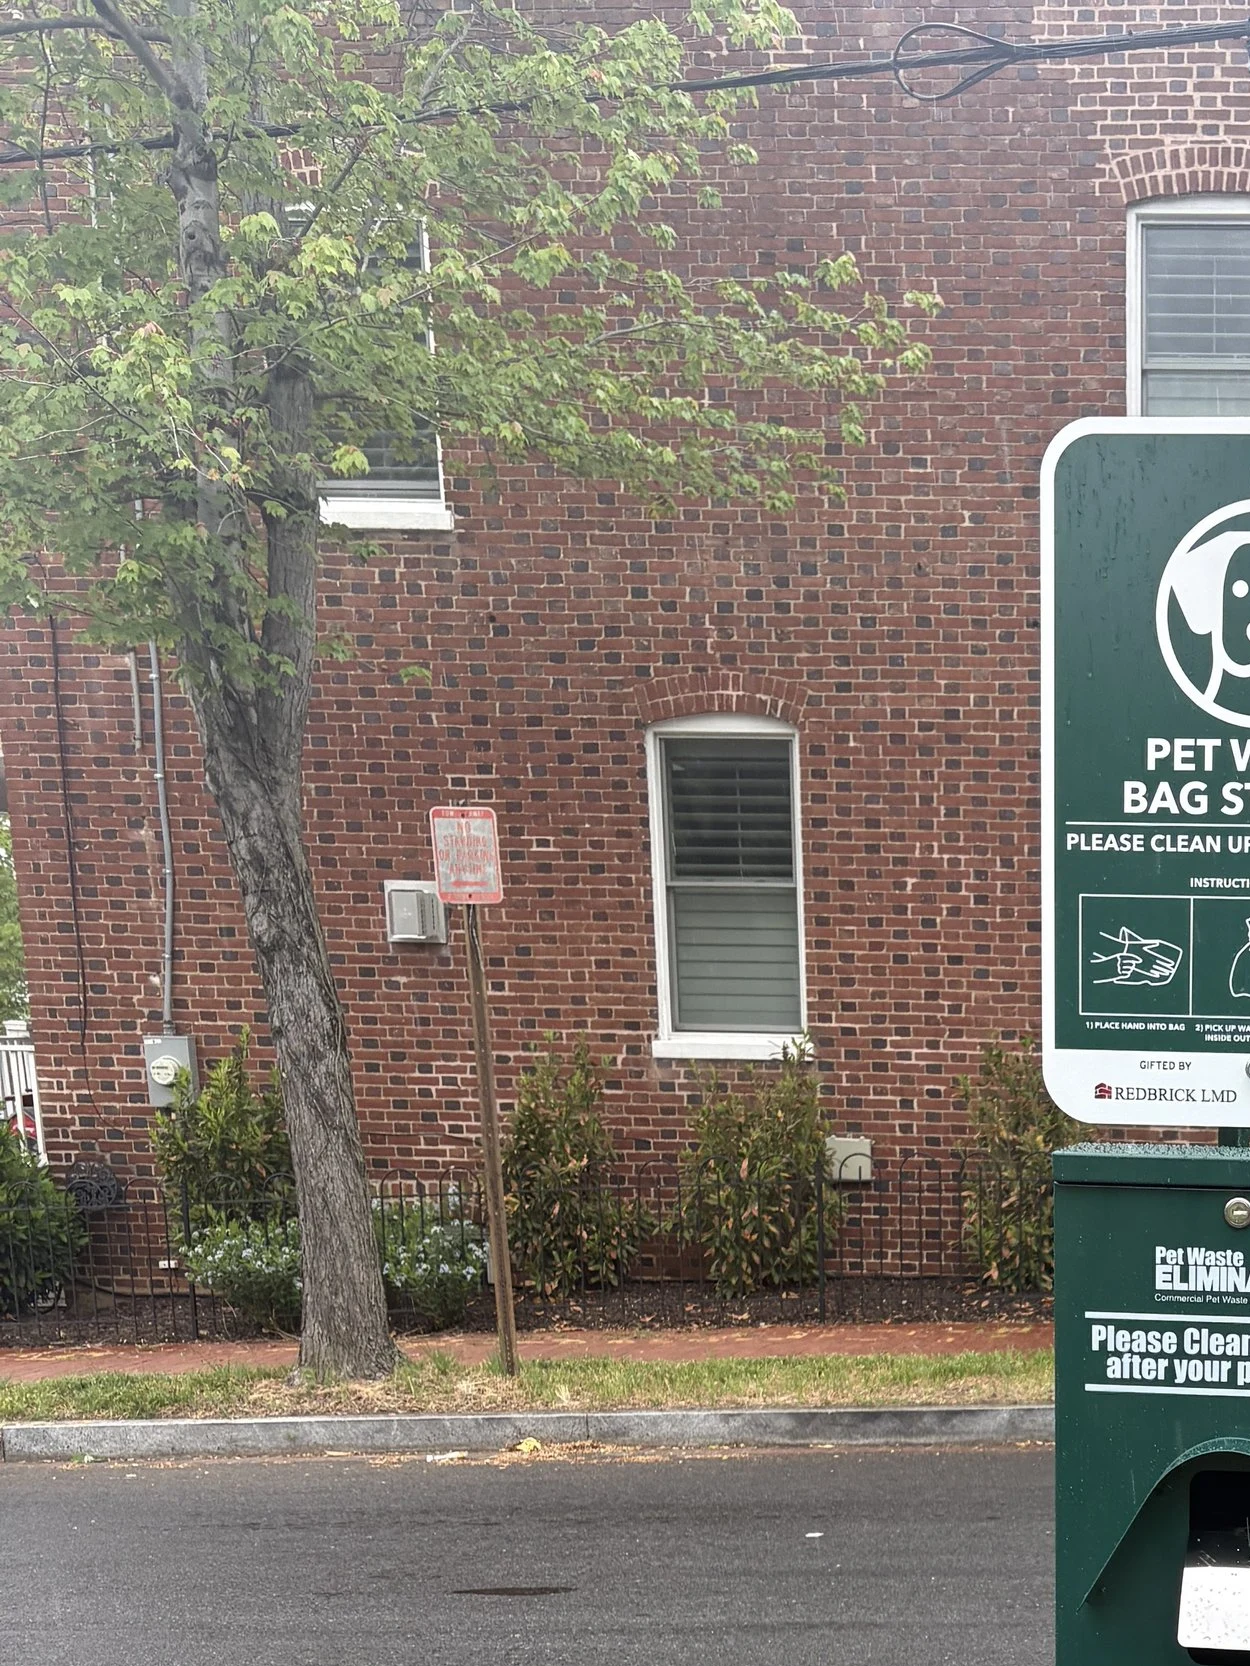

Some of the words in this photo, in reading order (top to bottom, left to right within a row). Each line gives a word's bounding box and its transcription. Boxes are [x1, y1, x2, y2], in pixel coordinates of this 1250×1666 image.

[1147, 738, 1221, 771] PET
[1124, 781, 1208, 814] BAG
[1067, 833, 1144, 851] PLEASE
[1151, 835, 1220, 852] CLEAN
[1086, 1022, 1094, 1030] 1)
[1095, 1022, 1120, 1030] PLACE
[1121, 1022, 1146, 1030] HAND
[1168, 1023, 1185, 1031] BAG
[1204, 1025, 1225, 1033] PICK
[1225, 1025, 1238, 1033] UP
[1205, 1034, 1232, 1042] INSIDE
[1233, 1034, 1250, 1043] OUT
[1140, 1061, 1175, 1070] GIFTED
[1179, 1062, 1191, 1070] BY
[1116, 1087, 1196, 1101] REDBRICK
[1202, 1089, 1236, 1102] LMD
[1155, 1246, 1184, 1265] Pet
[1187, 1247, 1244, 1267] Waste
[1154, 1293, 1203, 1302] Commercial
[1222, 1296, 1248, 1305] Waste
[1091, 1325, 1178, 1353] Please
[1106, 1354, 1168, 1380] after
[1173, 1358, 1232, 1384] your
